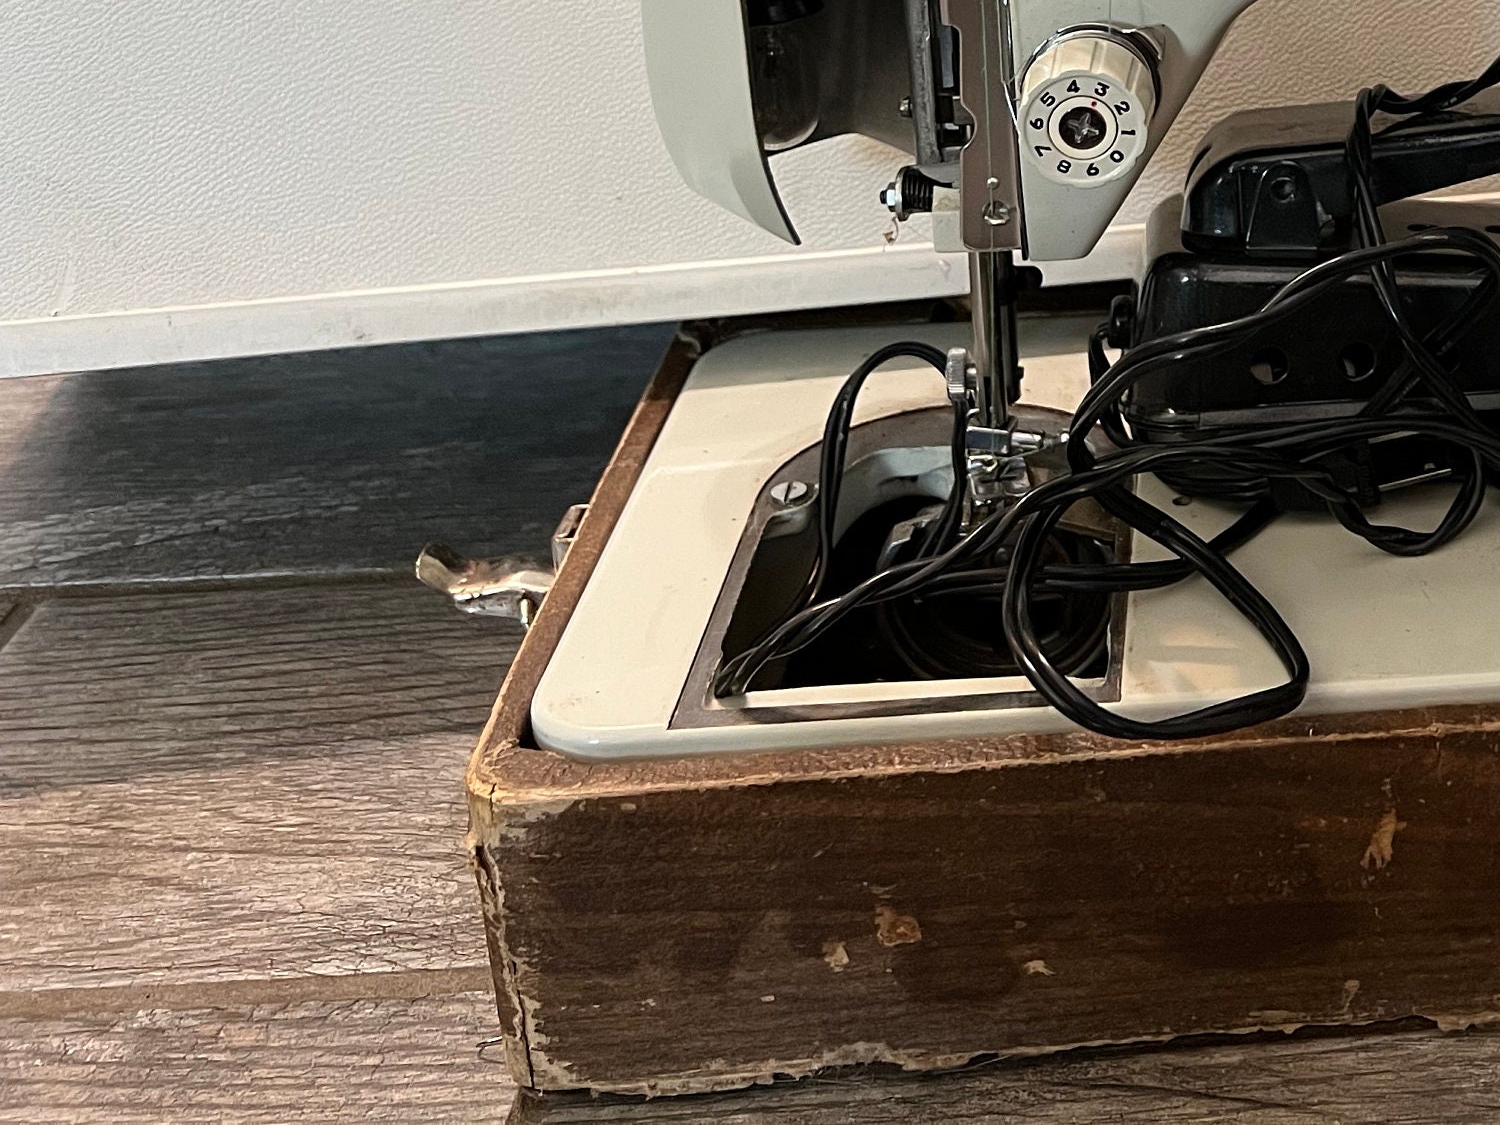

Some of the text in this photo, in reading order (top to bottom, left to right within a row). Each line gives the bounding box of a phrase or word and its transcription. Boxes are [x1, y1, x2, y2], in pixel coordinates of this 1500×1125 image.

[1067, 80, 1080, 94] 4
[1094, 82, 1110, 97] 3
[1040, 92, 1056, 107] 5
[1114, 101, 1131, 116] 2
[1029, 117, 1044, 130] 6
[1034, 145, 1052, 157] 7
[1110, 150, 1124, 163] 0
[1057, 160, 1072, 174] 8
[1086, 163, 1100, 176] 9
